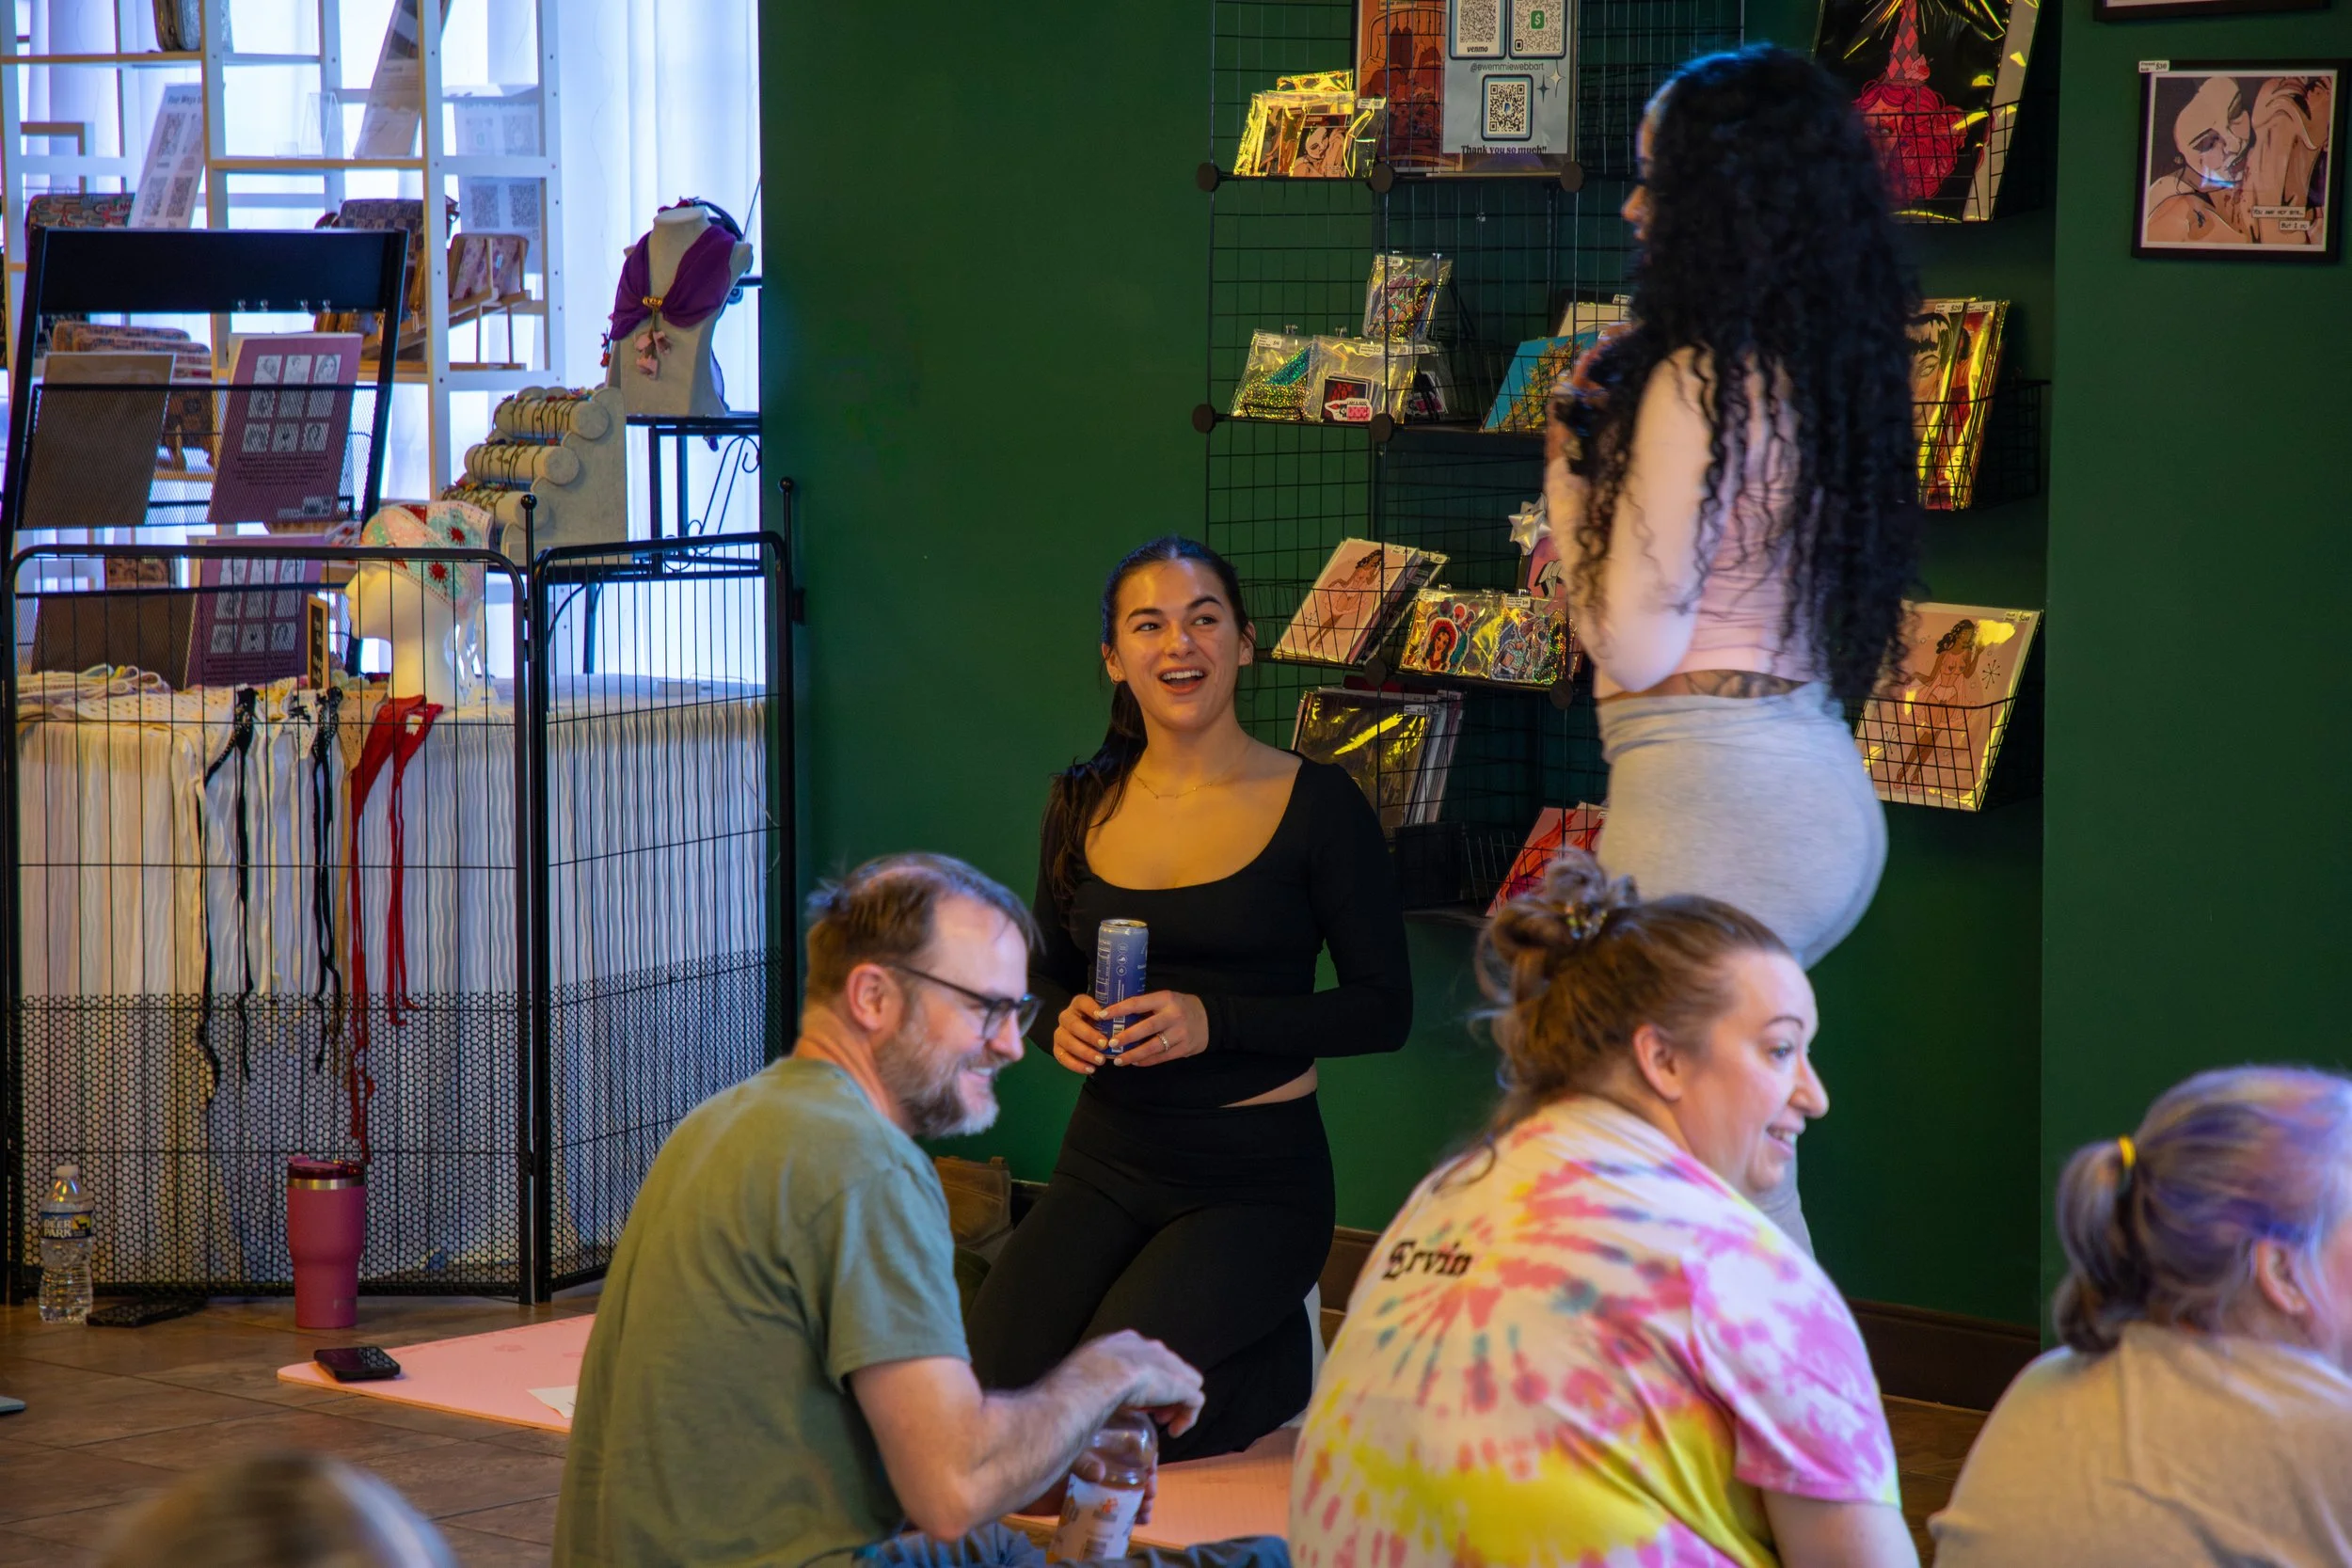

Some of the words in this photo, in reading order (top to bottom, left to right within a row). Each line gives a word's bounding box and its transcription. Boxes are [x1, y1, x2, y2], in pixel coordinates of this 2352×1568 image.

[1470, 61, 1545, 72] @ewemmiewebbart
[1461, 144, 1488, 154] Thank
[43, 1218, 72, 1228] DEER
[43, 1227, 72, 1238] PARK
[1382, 1239, 1472, 1281] Ervin
